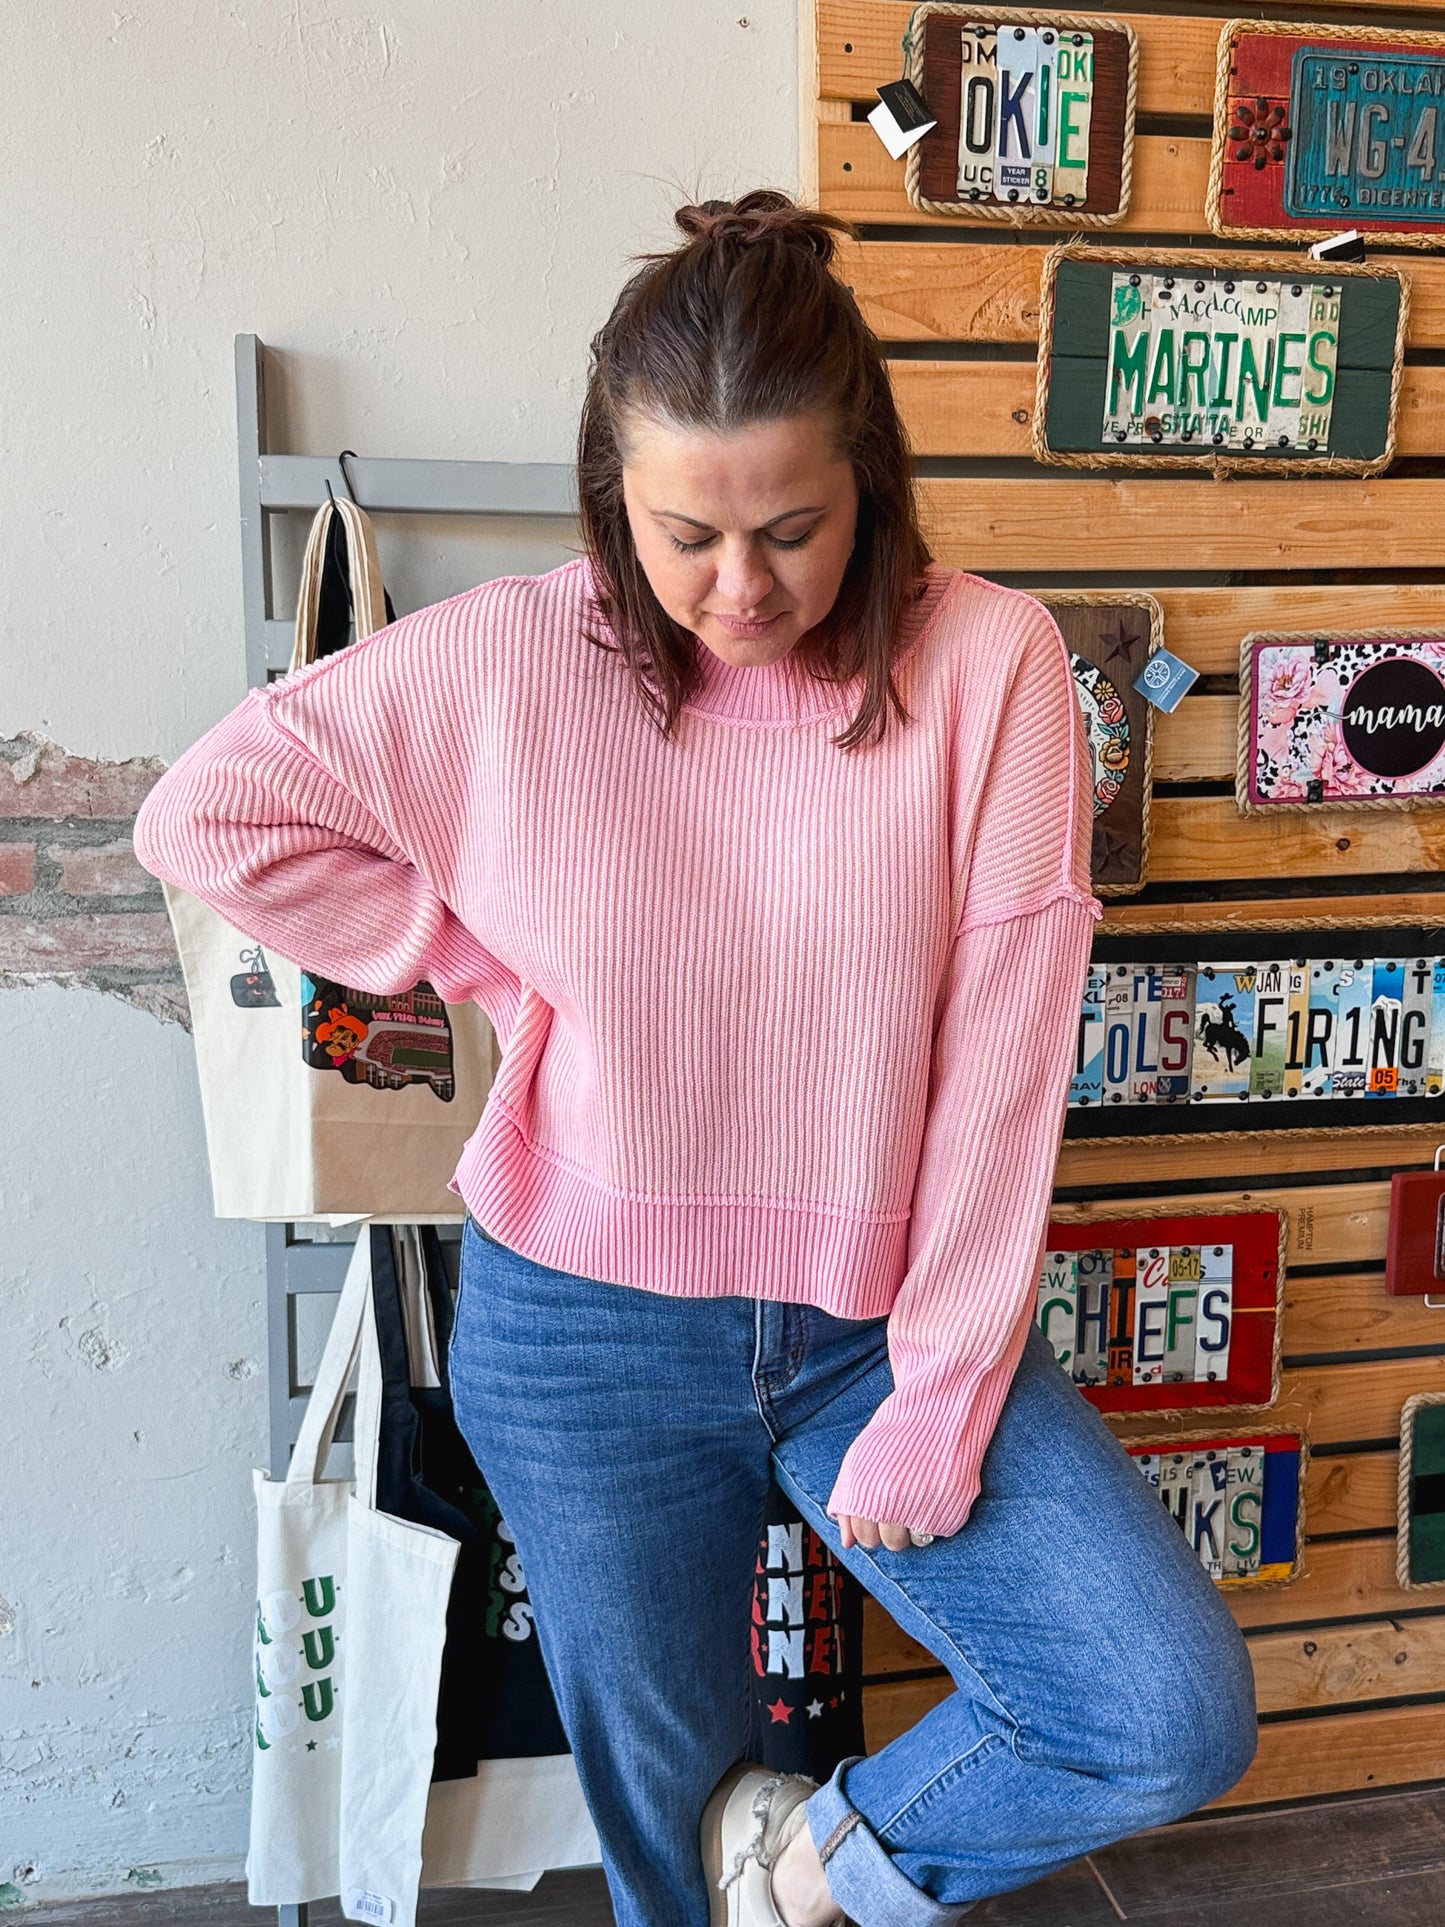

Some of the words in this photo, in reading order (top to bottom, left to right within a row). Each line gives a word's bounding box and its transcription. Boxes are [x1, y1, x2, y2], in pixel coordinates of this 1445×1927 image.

[1314, 66, 1348, 91] 19
[966, 64, 1089, 168] OKIE
[1326, 101, 1445, 181] WG-4
[1002, 176, 1030, 186] STICKER
[1007, 167, 1026, 176] YEAR
[1359, 187, 1445, 208] BICENTE
[1109, 328, 1337, 423] MARINES
[1345, 704, 1445, 735] mama
[1257, 971, 1281, 993] JAN
[1375, 1071, 1394, 1085] 05
[1041, 1278, 1229, 1364] CHIEFS
